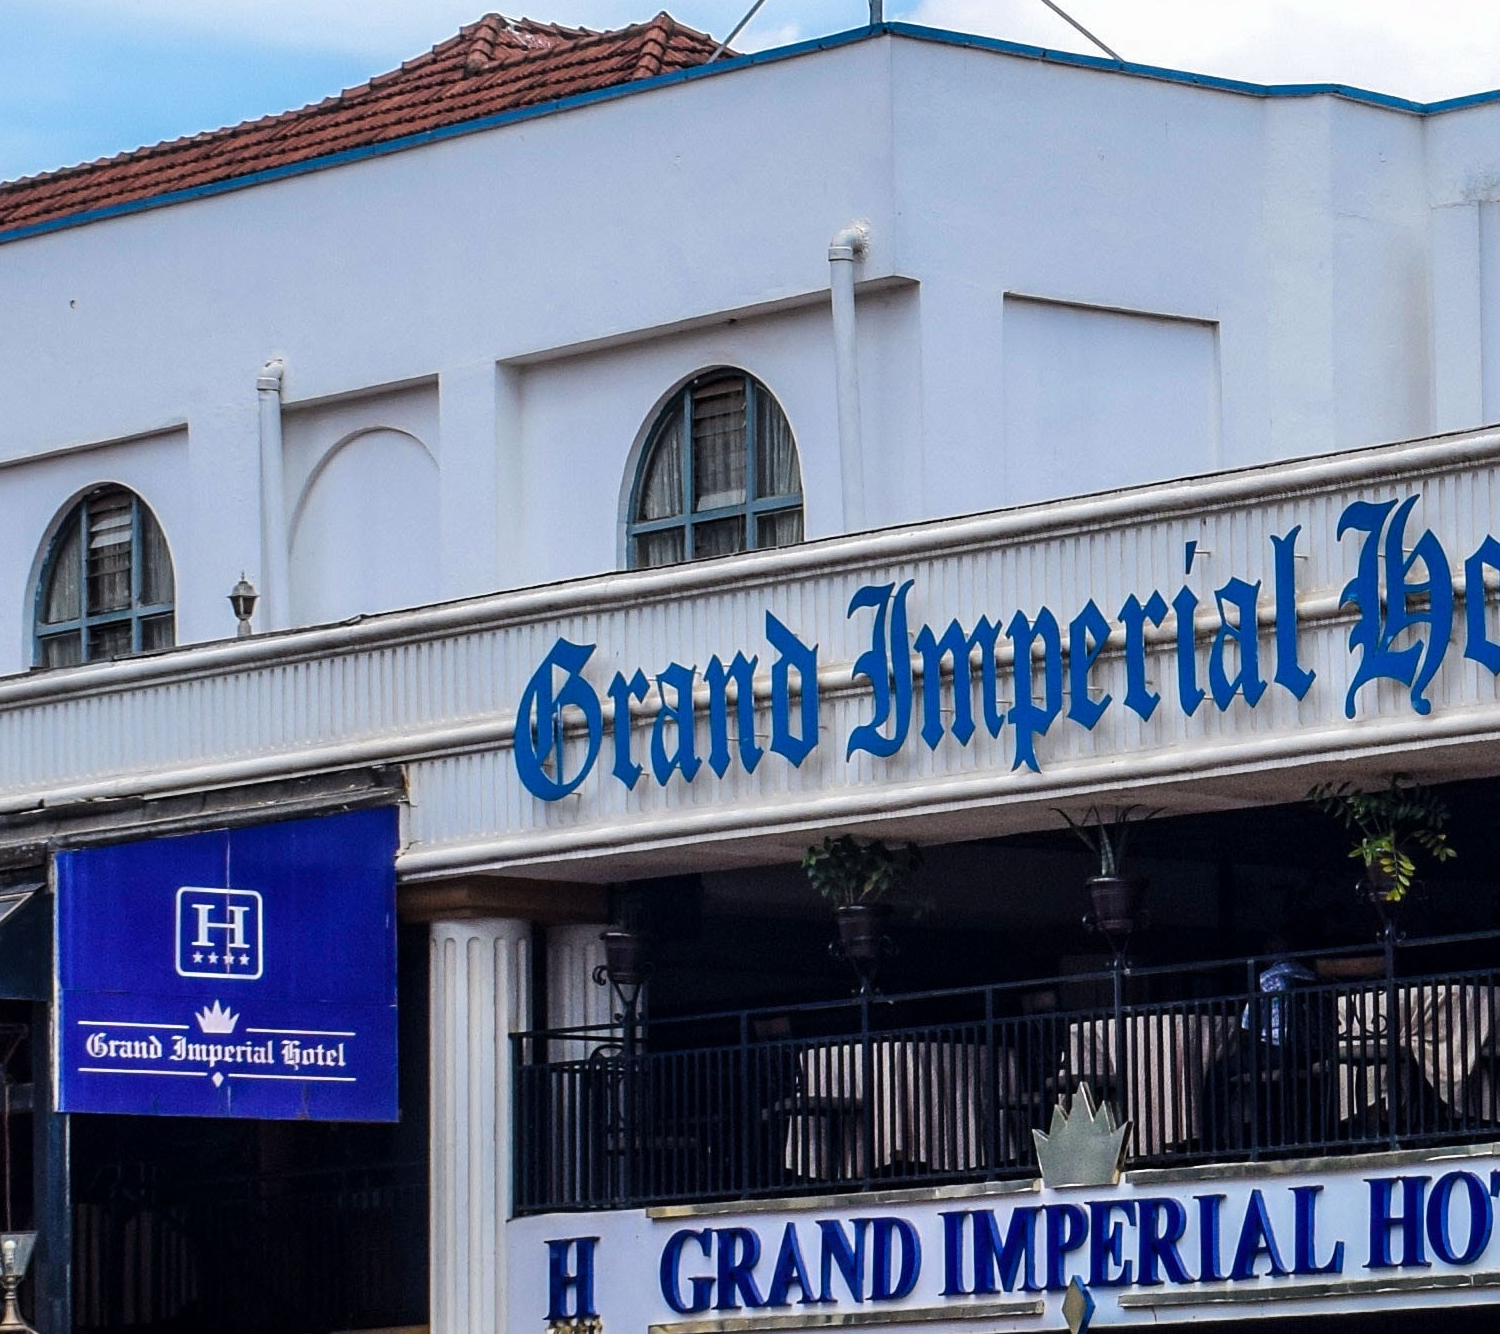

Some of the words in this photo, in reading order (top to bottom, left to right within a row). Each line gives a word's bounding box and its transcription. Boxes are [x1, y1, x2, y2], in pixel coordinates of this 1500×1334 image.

[513, 611, 819, 802] Grand
[847, 527, 1316, 774] Imperial
[85, 1032, 163, 1060] Grand
[168, 1034, 275, 1067] Imperial
[281, 1036, 347, 1071] Hotel
[544, 1236, 601, 1321] H
[659, 1217, 921, 1314] GRAND
[936, 1185, 1346, 1299] IMPERIAL
